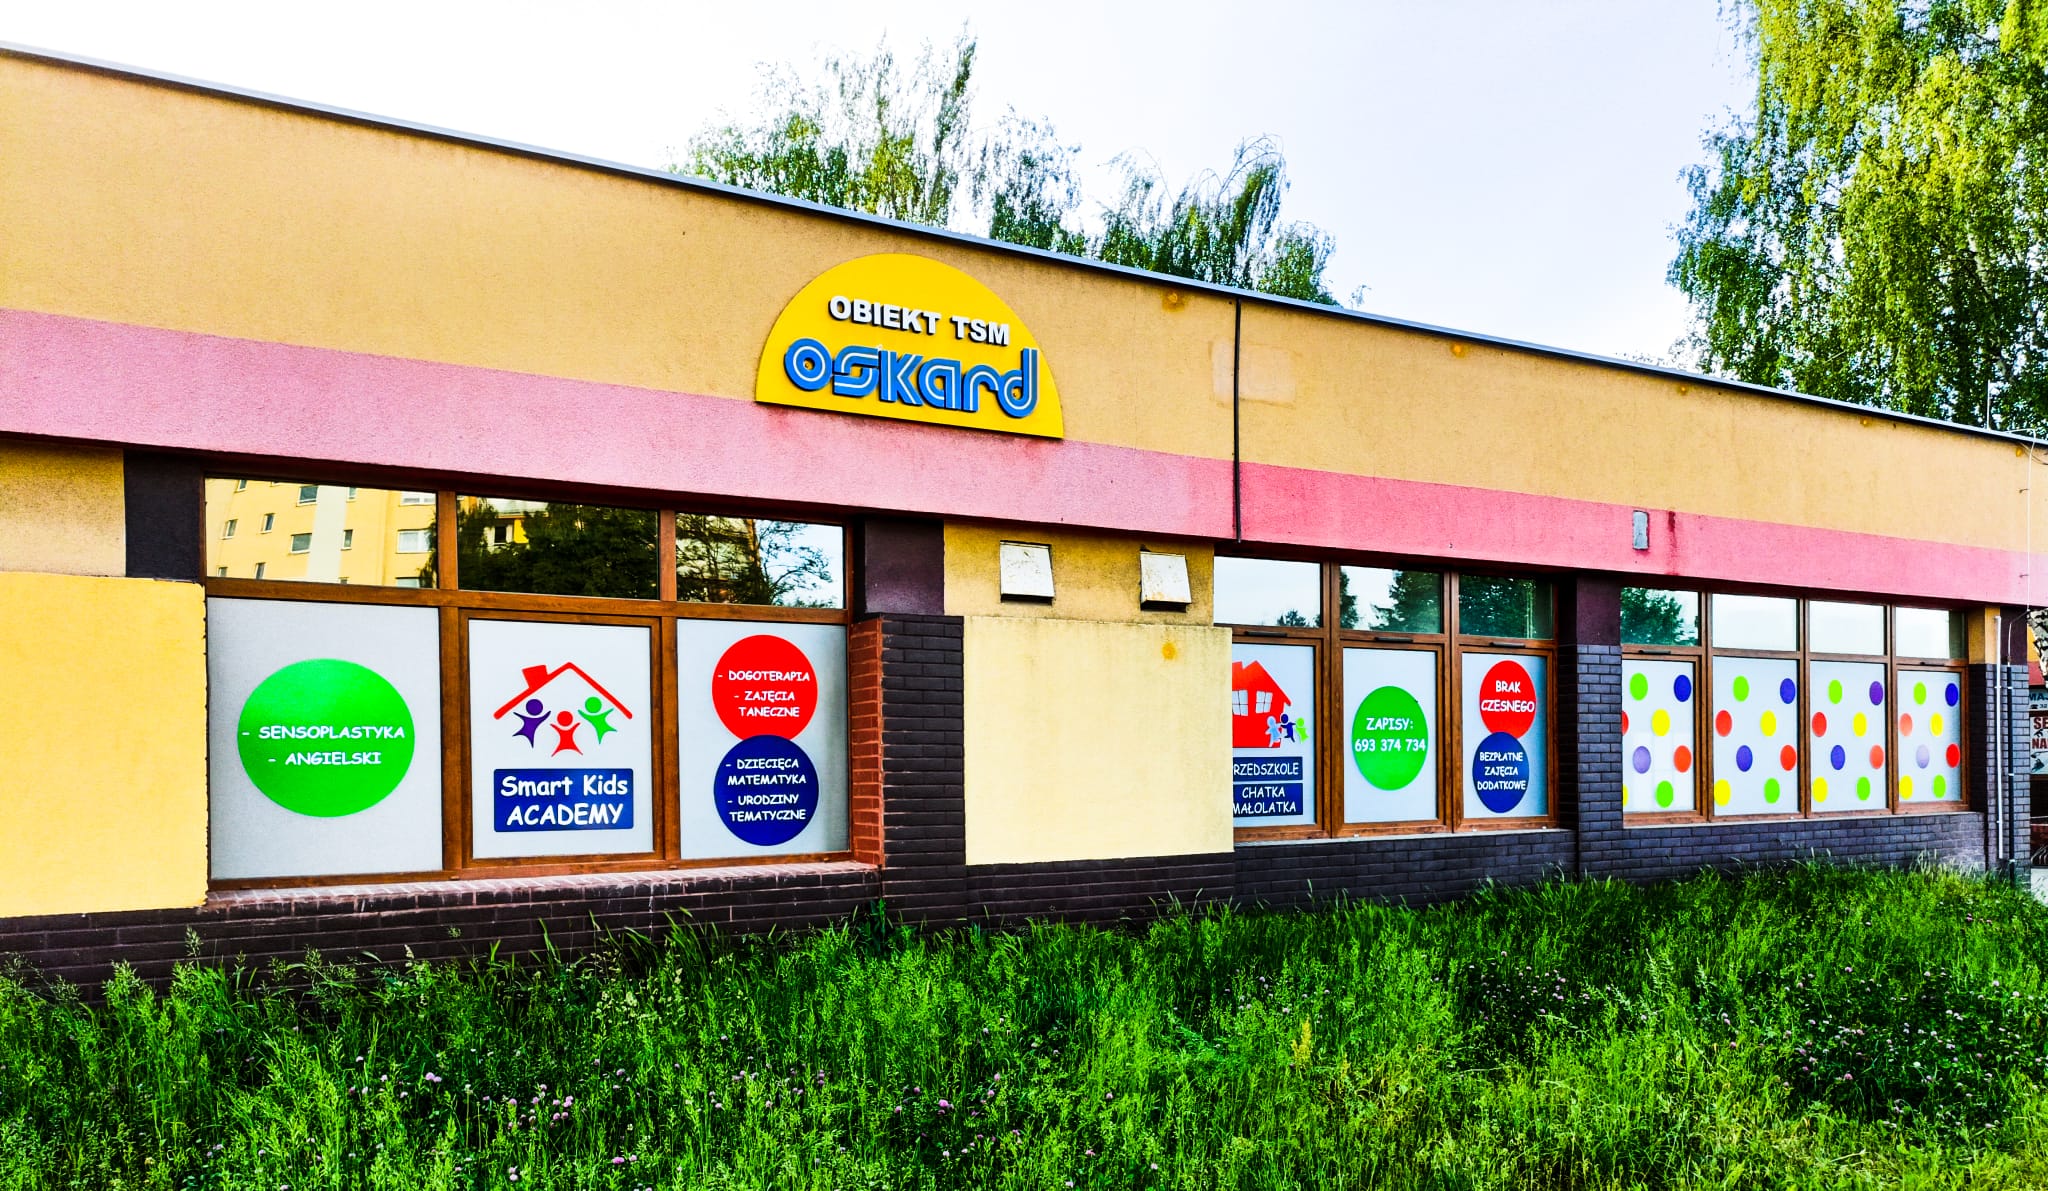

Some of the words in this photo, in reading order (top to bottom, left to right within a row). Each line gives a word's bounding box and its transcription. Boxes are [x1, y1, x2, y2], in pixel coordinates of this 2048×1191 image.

[828, 295, 942, 335] OBIEKT
[951, 315, 1011, 347] TSM
[729, 670, 810, 682] DOGOTERAPIA
[1495, 681, 1521, 693] BRAK
[745, 690, 795, 703] ZAJĘCIA
[739, 706, 800, 718] TANECZNE
[1481, 700, 1535, 713] CZESNEGO
[1366, 716, 1414, 732] ZAPISY:
[259, 725, 405, 739] SENSOPLASTYKA
[1354, 738, 1376, 752] 693
[1380, 738, 1402, 751] 374
[1405, 738, 1427, 751] 734
[285, 751, 381, 765] ANGIELSKI
[1479, 751, 1523, 762] BEZPŁATNE
[737, 758, 799, 771] DZIECIĘCA
[1234, 762, 1299, 776] RZEDSZKOLE
[1484, 765, 1519, 777] ZAJĘCIA
[501, 775, 573, 797] Smart
[583, 773, 628, 796] Kids
[728, 774, 807, 786] MATEMATYKA
[1477, 780, 1526, 791] DODATKOWE
[1242, 786, 1285, 799] CHATKA
[739, 794, 800, 806] URODZINY
[507, 802, 624, 826] ACADEMY
[1233, 801, 1297, 815] MAŁOLATKA
[730, 809, 807, 822] TEMATYCZNE
